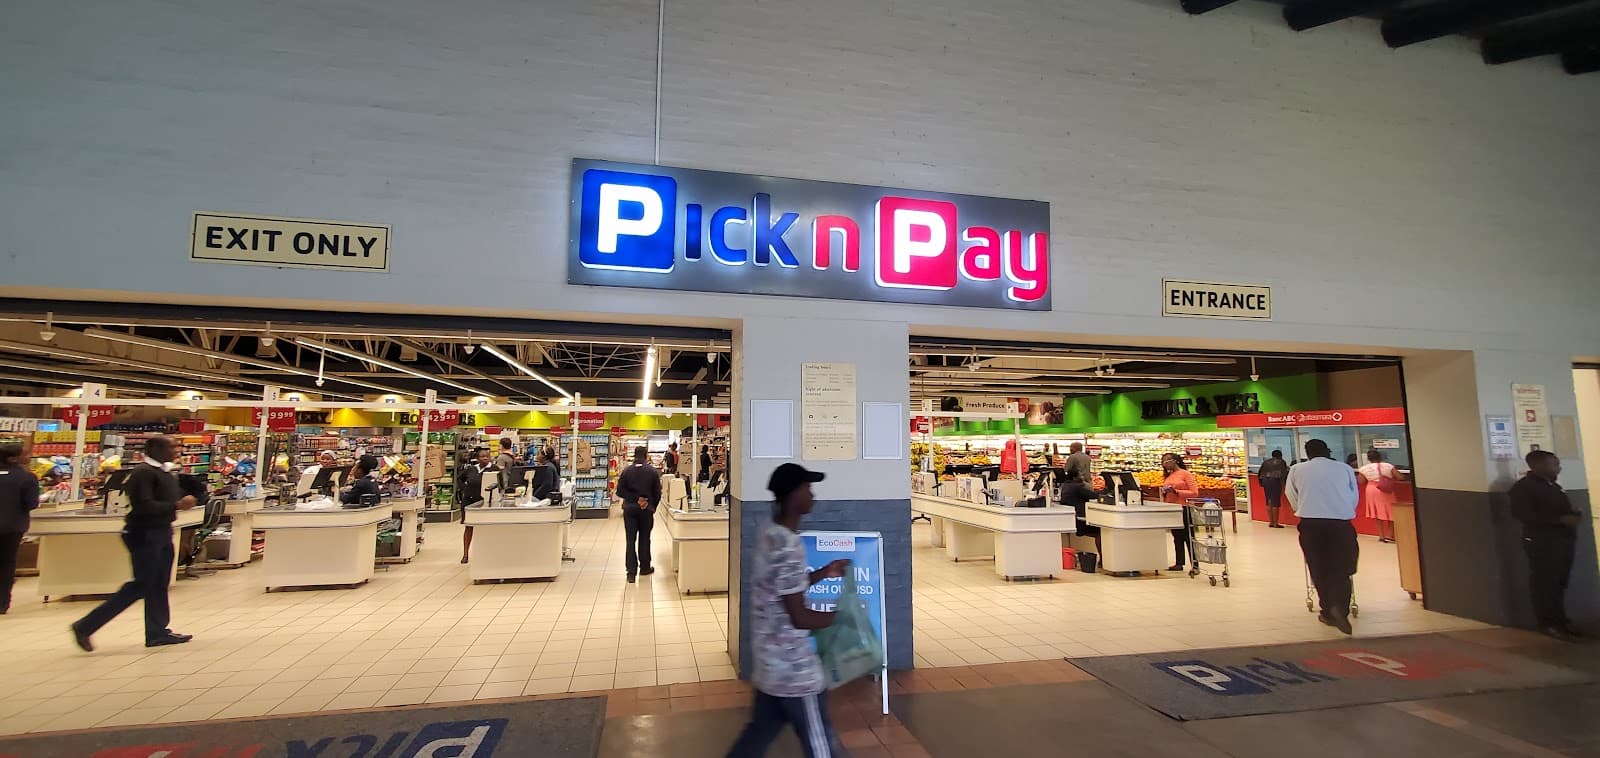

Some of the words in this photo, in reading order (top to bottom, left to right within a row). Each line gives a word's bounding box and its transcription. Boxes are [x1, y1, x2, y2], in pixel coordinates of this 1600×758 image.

[205, 226, 283, 252] EXIT
[293, 231, 378, 258] ONLY
[588, 176, 800, 271] Pick
[812, 214, 861, 272] n
[880, 200, 1048, 302] Pay
[1170, 289, 1266, 311] ENTRANCE
[94, 389, 100, 397] 4
[818, 539, 853, 547] EcoCash
[805, 585, 829, 594] ASH
